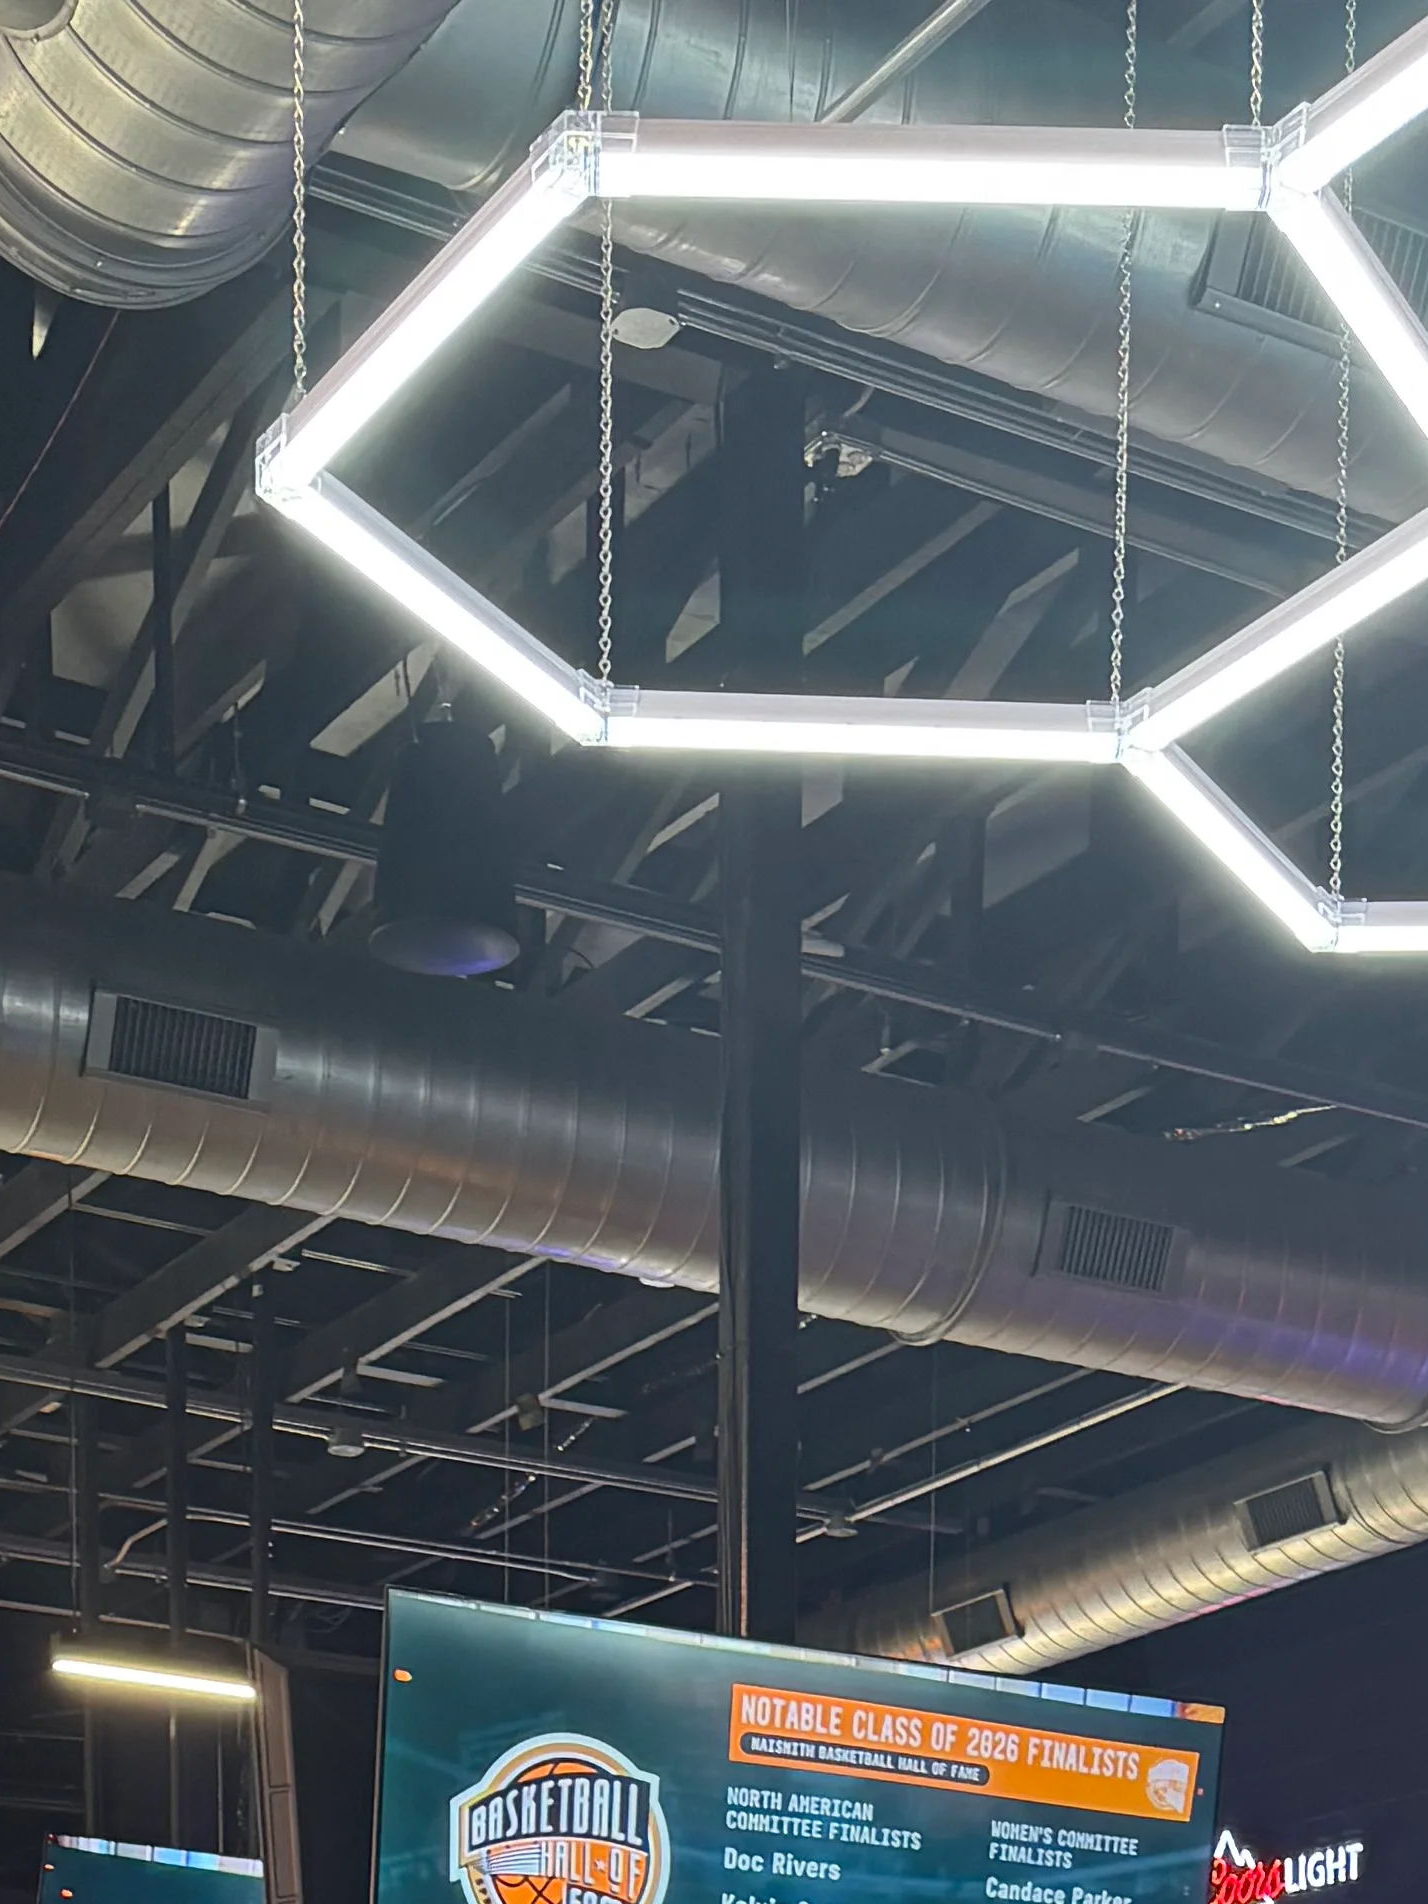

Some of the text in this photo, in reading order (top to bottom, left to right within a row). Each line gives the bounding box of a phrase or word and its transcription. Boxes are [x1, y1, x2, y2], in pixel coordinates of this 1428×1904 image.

[740, 1694, 1140, 1781] NOTABLE CLASS OF 2026 FINALISTS
[751, 1736, 980, 1782] NAISMITH BASKETBALL HALL OF FAME
[472, 1778, 642, 1846] BASKETBALL
[727, 1786, 873, 1821] NORTH AMERICAN
[726, 1810, 922, 1850] COMMITTEE FINALISTS
[991, 1820, 1138, 1855] WOMEN'S COMMITTEE
[541, 1840, 640, 1900] HALL OF
[724, 1847, 841, 1880] Doc Rivers
[989, 1843, 1072, 1868] FINALISTS
[1284, 1842, 1364, 1895] LIGHT
[986, 1877, 1065, 1904] Candace
